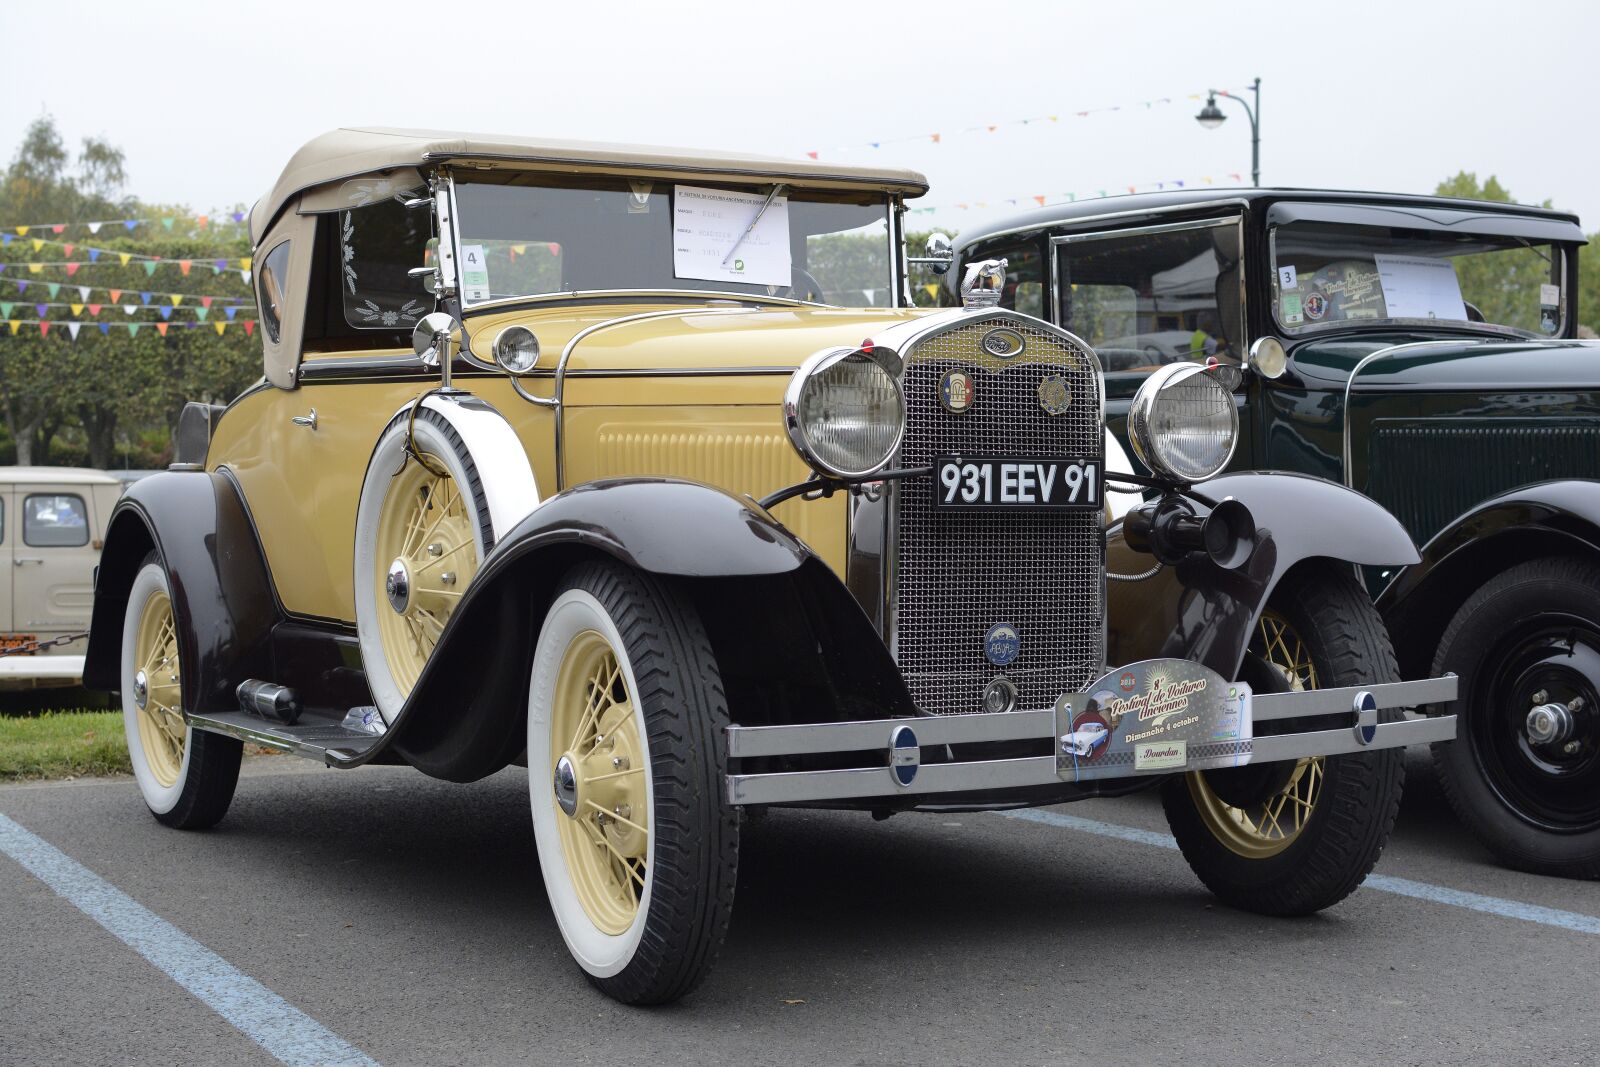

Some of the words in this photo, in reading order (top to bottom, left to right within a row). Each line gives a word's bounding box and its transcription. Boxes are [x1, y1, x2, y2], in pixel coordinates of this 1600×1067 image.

[467, 252, 477, 264] 4
[1284, 272, 1292, 283] 3
[941, 463, 993, 503] 931
[1000, 464, 1058, 503] EEV
[1064, 464, 1096, 503] 91
[1120, 677, 1136, 686] 2015
[1111, 691, 1153, 716] Festival
[1153, 689, 1166, 704] de
[1166, 680, 1206, 700] Voitures
[1139, 697, 1188, 720] Anciennes
[1125, 726, 1165, 743] Dimanche
[1166, 723, 1171, 731] 4
[1172, 715, 1199, 729] octobre
[1143, 747, 1179, 759] Dourdan
